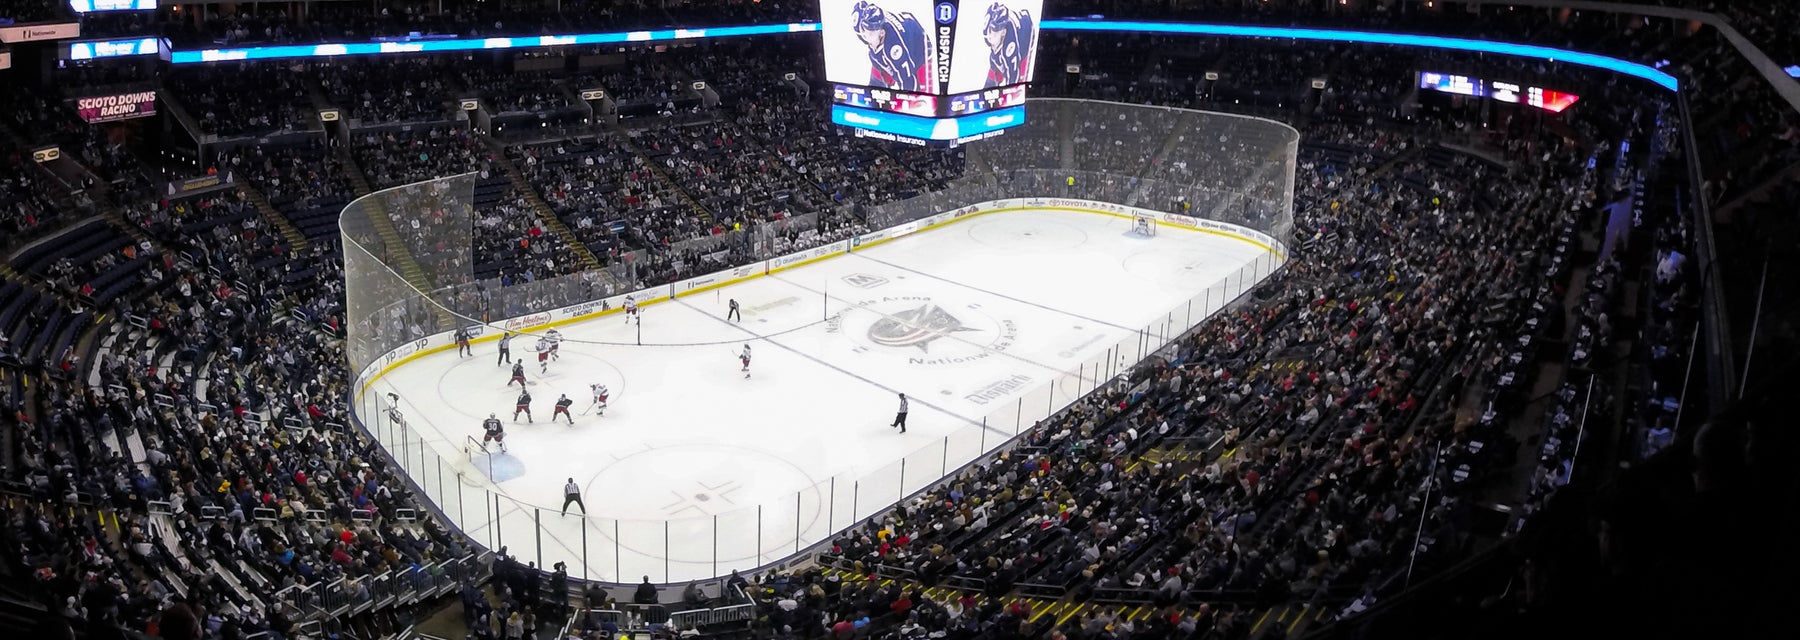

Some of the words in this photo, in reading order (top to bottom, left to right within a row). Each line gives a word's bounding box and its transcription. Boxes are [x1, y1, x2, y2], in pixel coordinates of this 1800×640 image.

[939, 26, 951, 83] DISPATCH
[78, 96, 116, 110] SCIOTO
[118, 91, 156, 105] DOWNS
[101, 103, 136, 117] RACINO
[863, 129, 895, 142] Nationwide
[897, 134, 926, 147] Insurance
[958, 133, 983, 145] Nationwide
[984, 128, 1005, 140] Insurance
[1061, 200, 1088, 208] TOYOTA
[562, 304, 582, 315] SCIOTO
[572, 308, 593, 317] RACINO
[509, 318, 522, 329] Tim
[415, 338, 429, 351] yp
[385, 350, 397, 365] yp
[487, 422, 498, 431] 30
